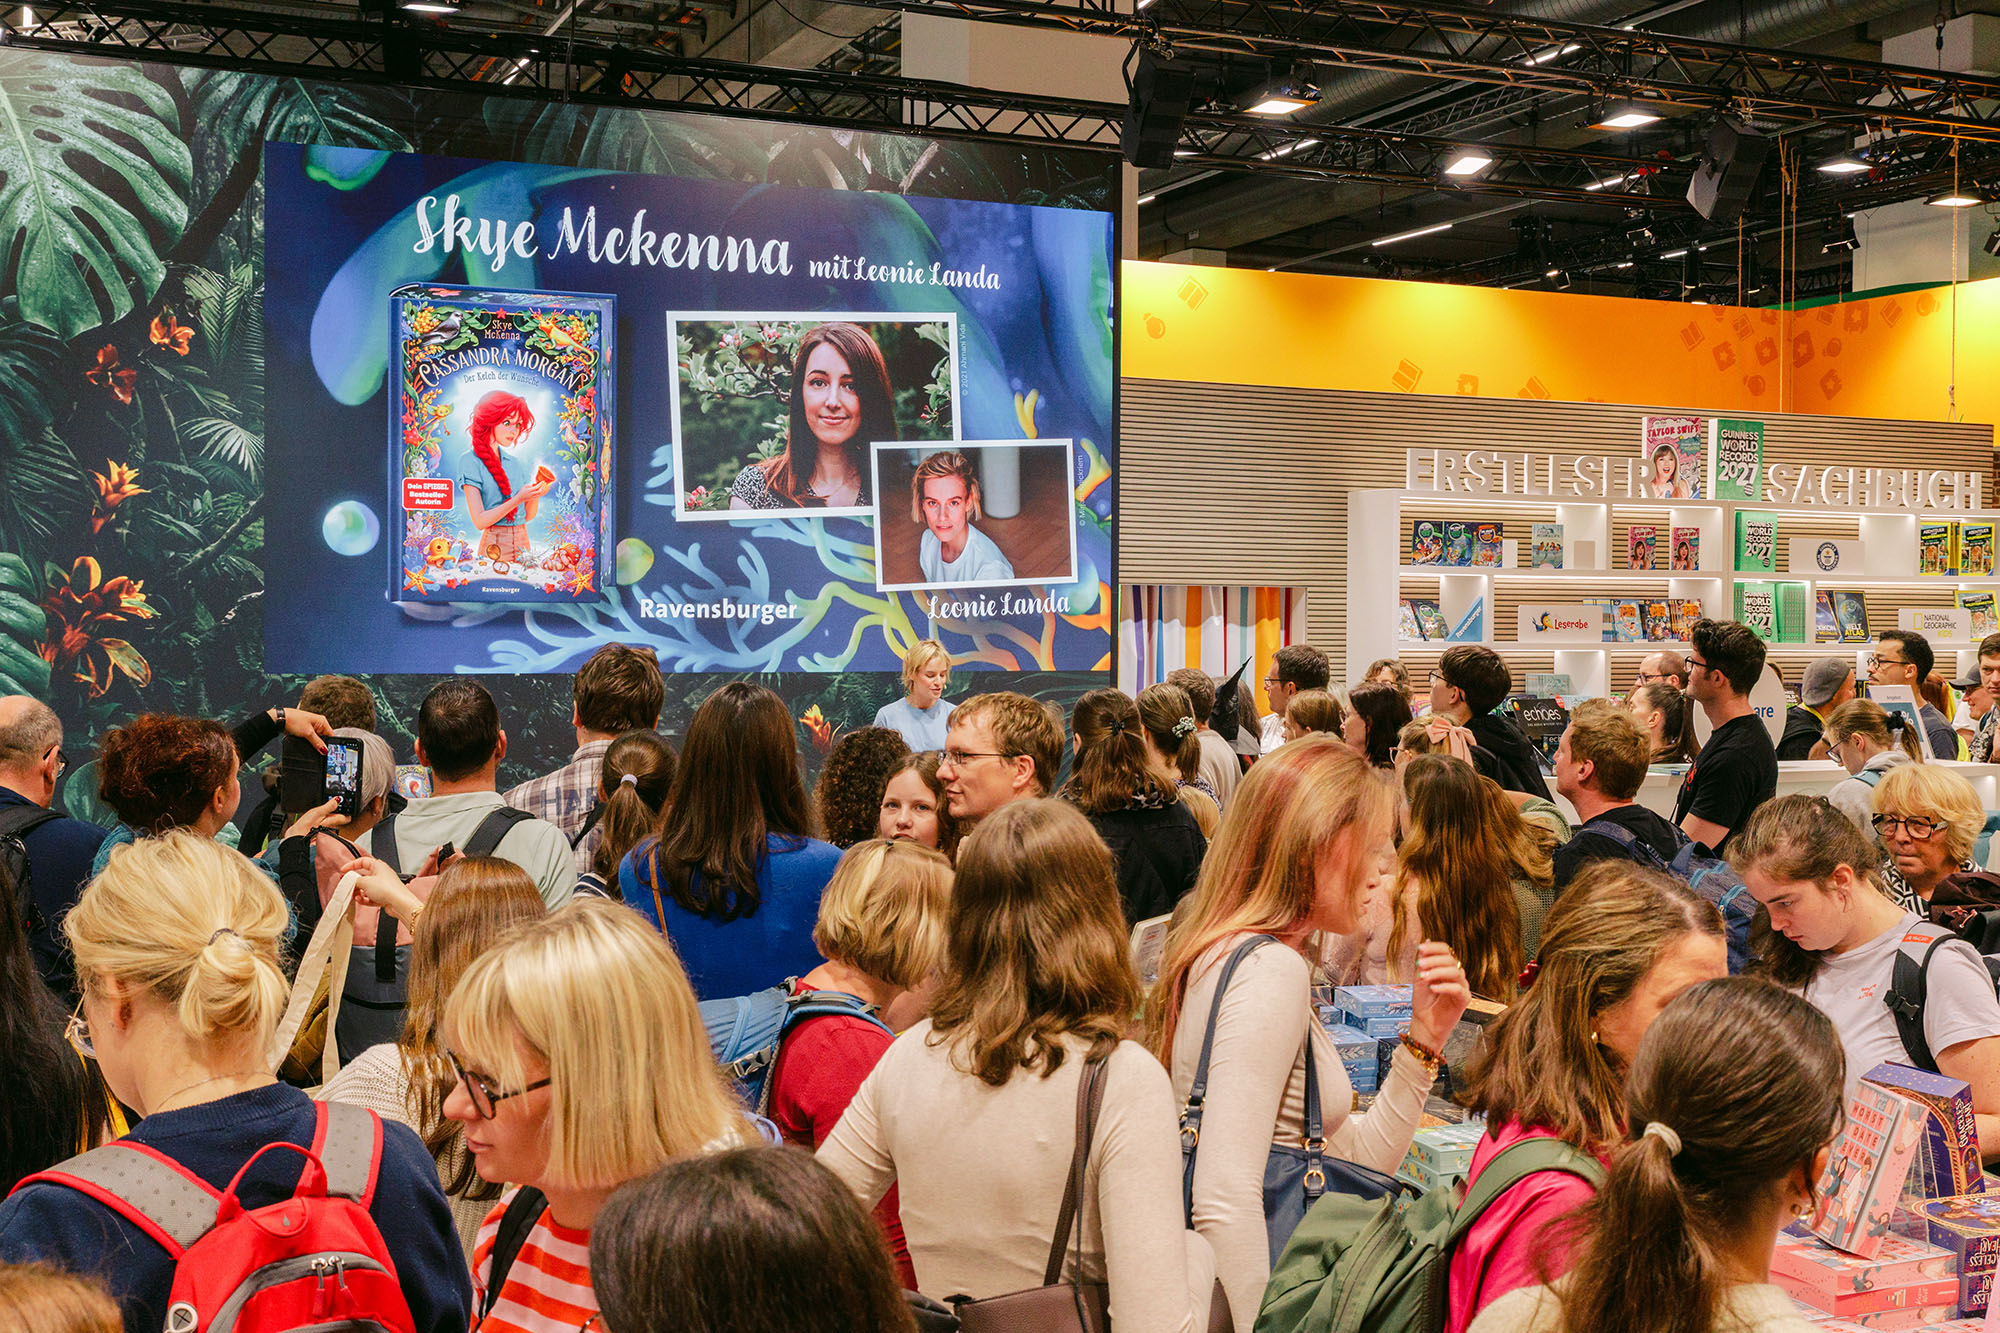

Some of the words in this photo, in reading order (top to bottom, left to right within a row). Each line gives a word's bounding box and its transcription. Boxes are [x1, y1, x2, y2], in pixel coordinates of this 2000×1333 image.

[412, 194, 538, 272] Skye
[549, 204, 793, 275] Mckenna
[809, 256, 851, 281] mit
[853, 256, 927, 289] Leonie
[929, 258, 1001, 292] Landa
[492, 320, 512, 331] Skye
[484, 329, 520, 340] McKenna
[418, 346, 510, 388] CASSANDRA
[514, 349, 590, 391] MORGAN
[960, 370, 969, 388] 2021
[1647, 427, 1675, 438] TAYLOR
[1677, 424, 1699, 435] SWIFT
[1720, 429, 1760, 441] GUINNESS
[1720, 440, 1759, 452] WORLD
[1719, 451, 1759, 462] RECORDS
[1405, 447, 1656, 499] ERSTLESER
[1718, 461, 1759, 486] 2027
[1767, 463, 1982, 510] SACHBUCH
[1746, 527, 1773, 536] WORLD
[1744, 543, 1774, 561] 2027
[926, 591, 998, 621] Leonie
[999, 588, 1071, 616] Landa
[1743, 597, 1772, 605] WORLD
[639, 598, 799, 626] Ravensburger
[1924, 614, 1950, 622] NATIONAL
[1554, 618, 1589, 630] Leserabe
[1743, 612, 1773, 630] 2027
[1523, 705, 1562, 721] echoes
[1852, 1126, 1879, 1148] DATE
